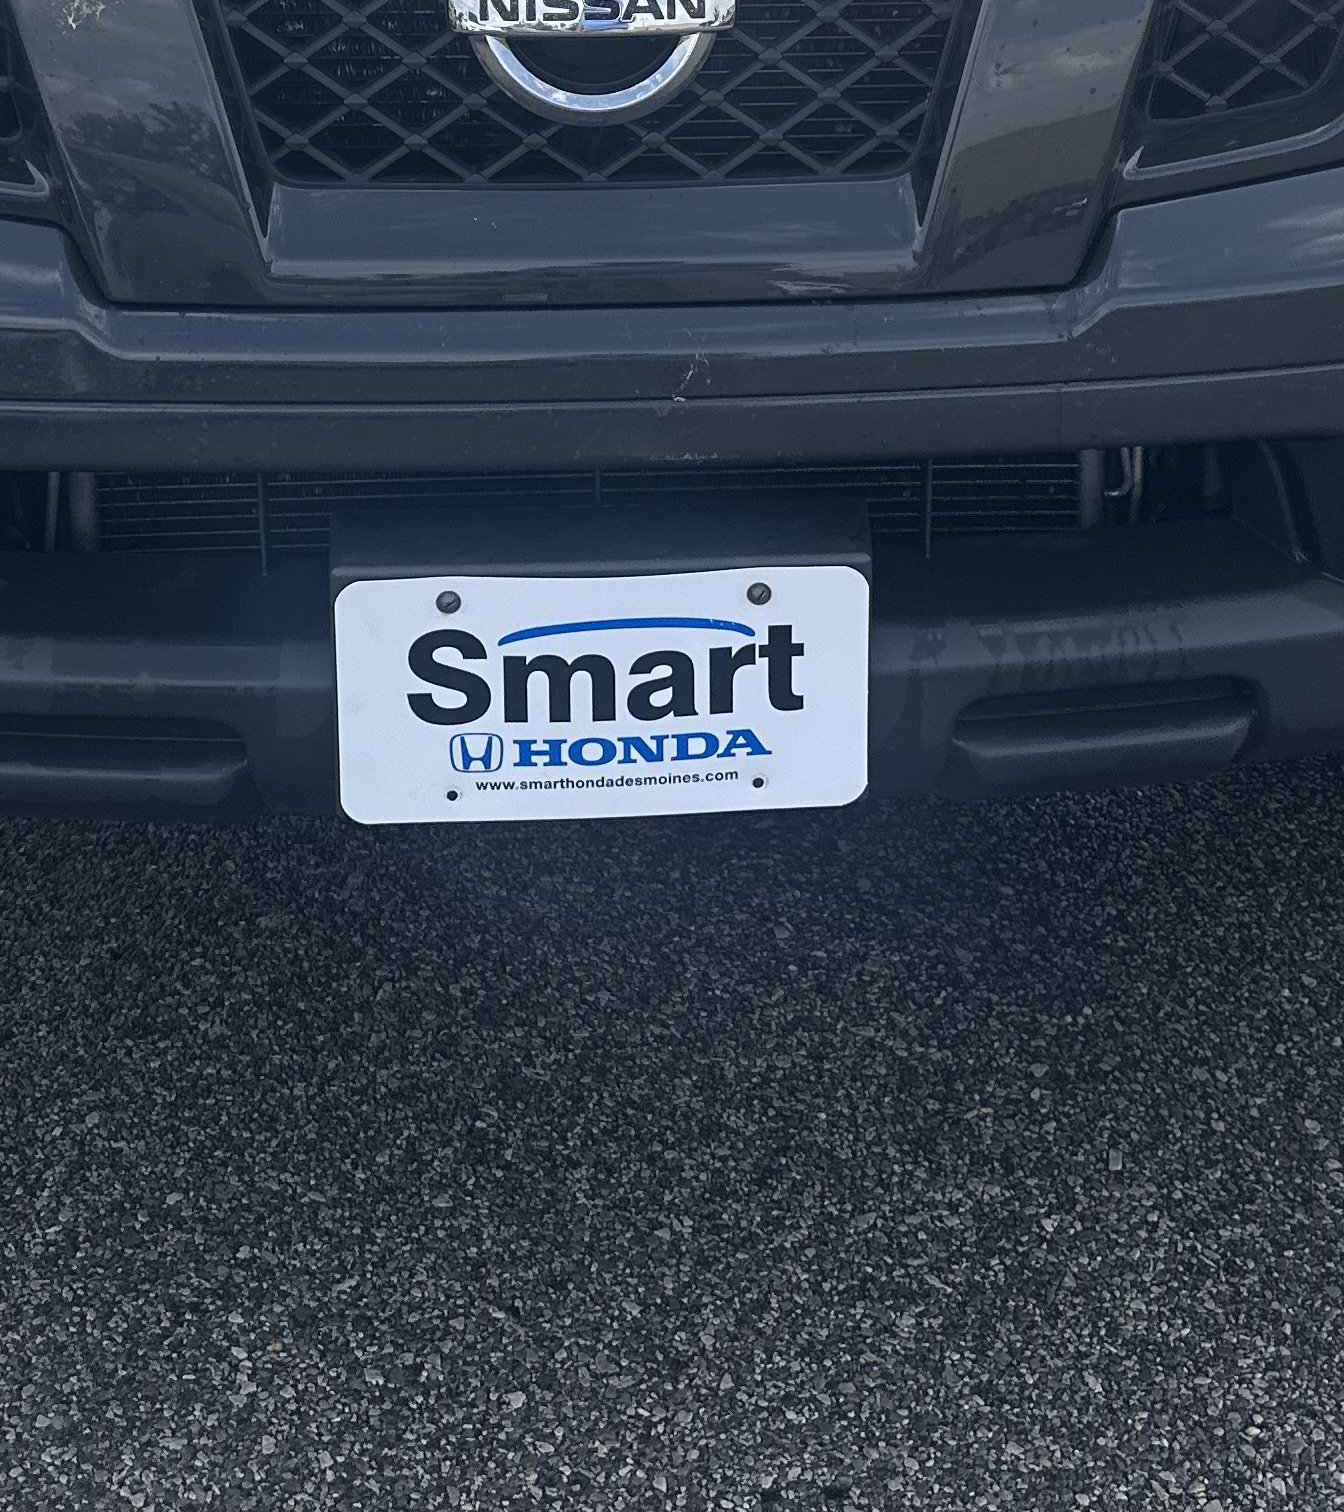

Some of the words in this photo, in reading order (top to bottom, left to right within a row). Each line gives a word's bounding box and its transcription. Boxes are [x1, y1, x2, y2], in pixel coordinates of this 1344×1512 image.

[407, 624, 805, 726] Smart
[512, 728, 773, 768] HONDA
[475, 770, 740, 793] www.smarthondadesmoines.com
